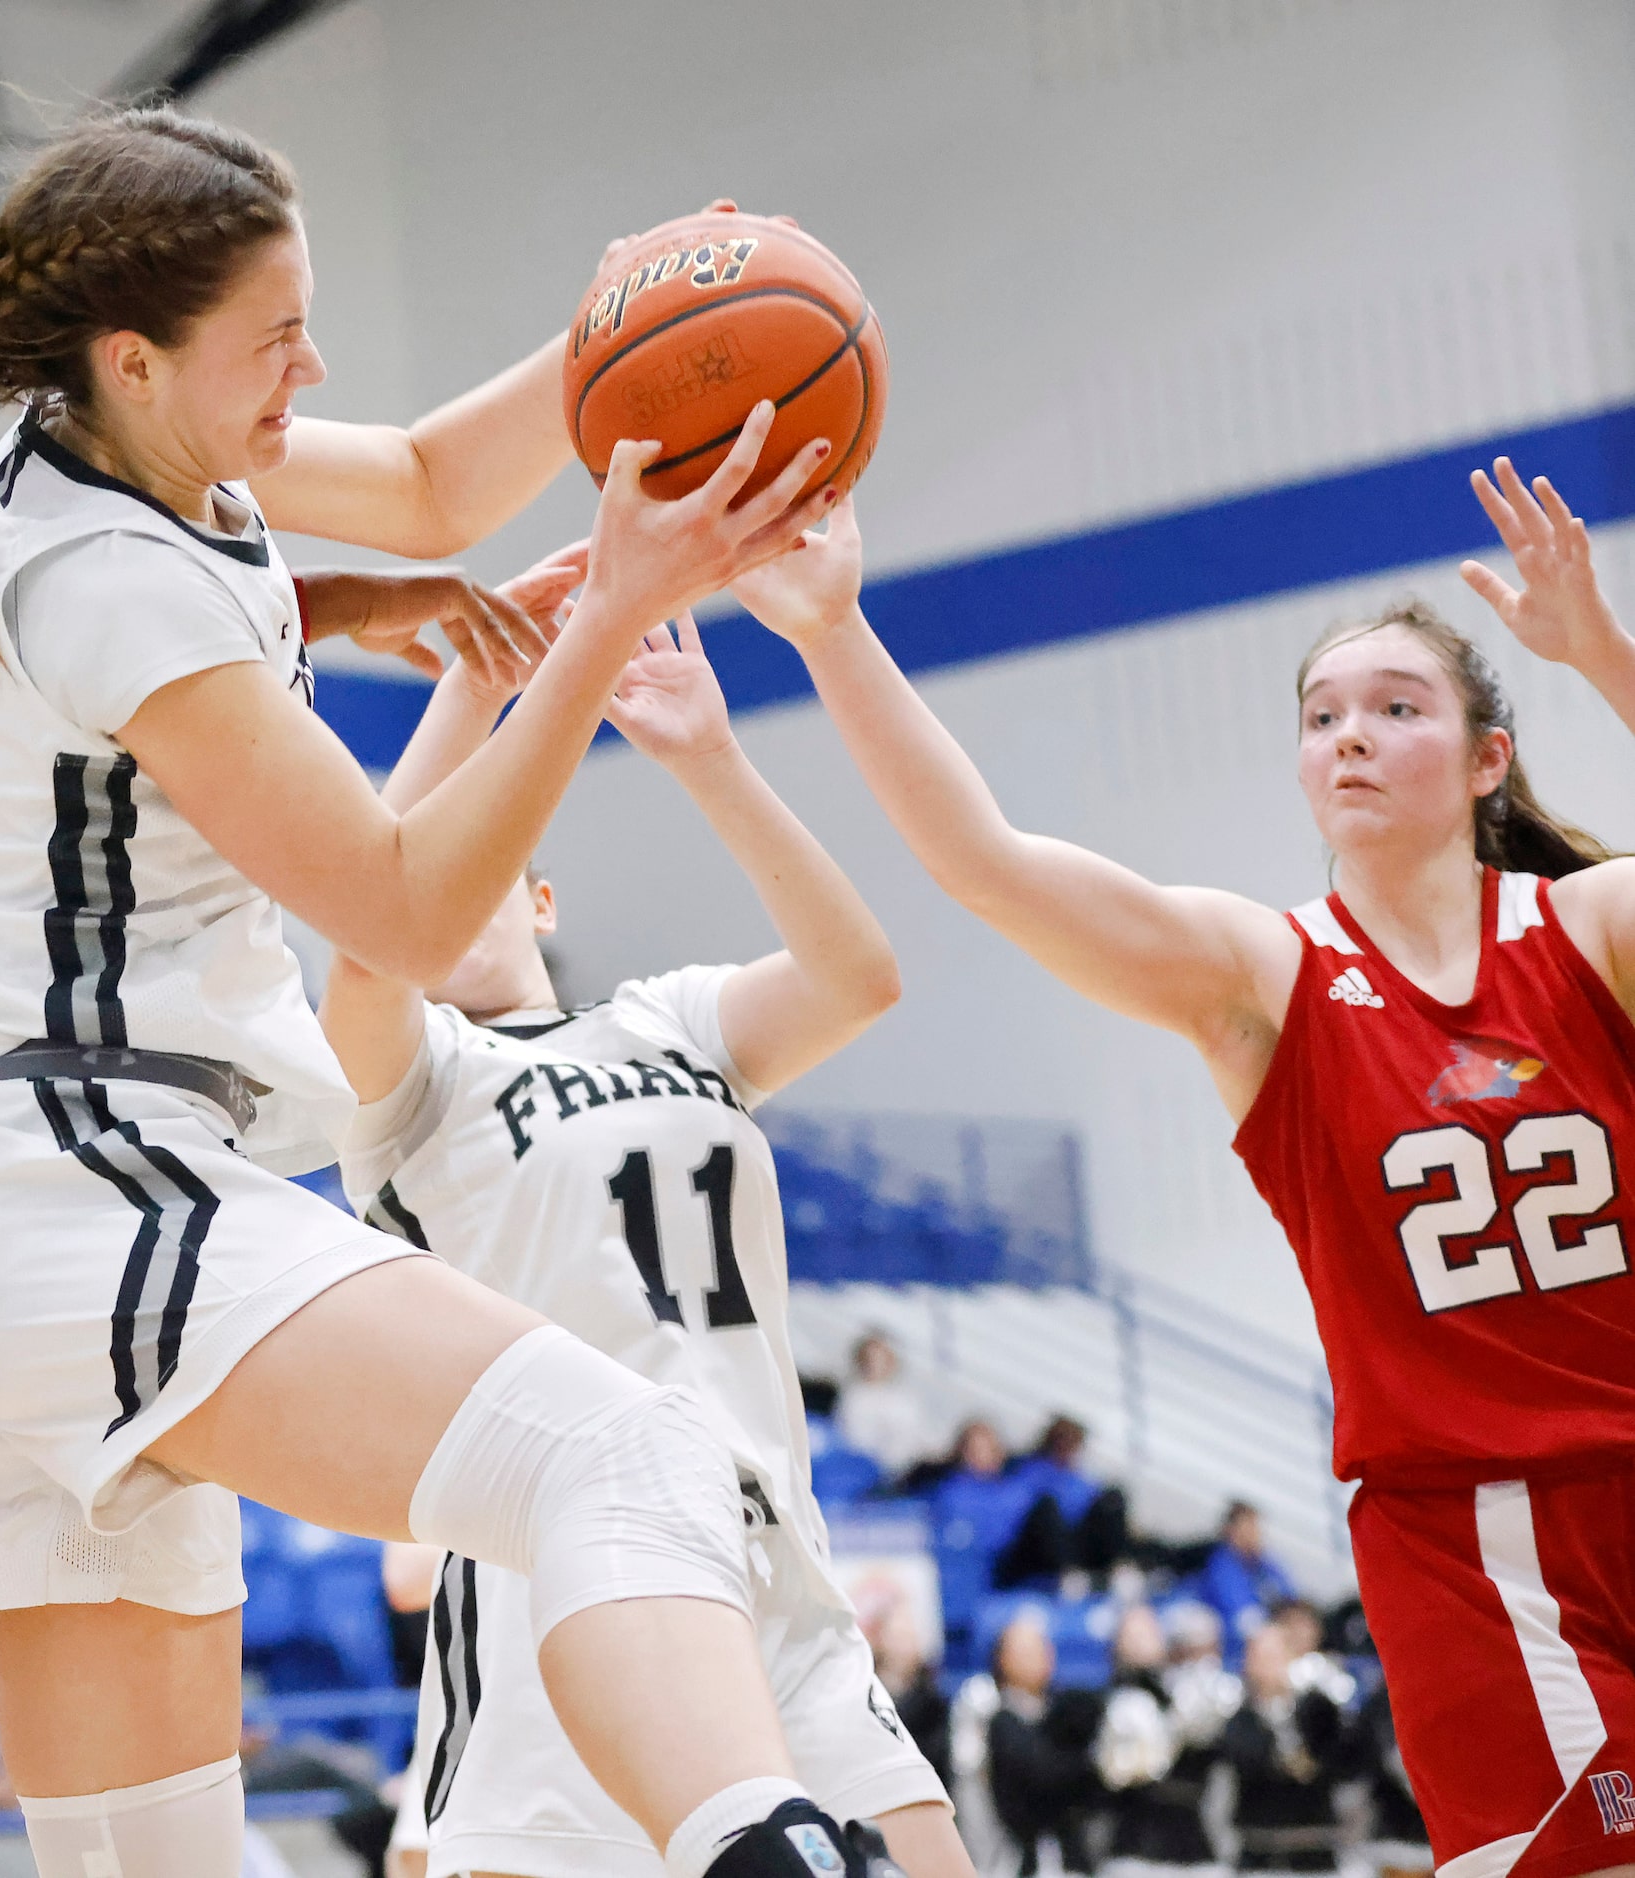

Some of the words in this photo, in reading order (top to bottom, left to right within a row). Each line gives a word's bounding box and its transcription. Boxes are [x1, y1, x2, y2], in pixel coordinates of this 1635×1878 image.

[495, 1050, 754, 1163] FRIAR
[604, 1143, 757, 1333] 11
[1380, 1109, 1630, 1314] 22
